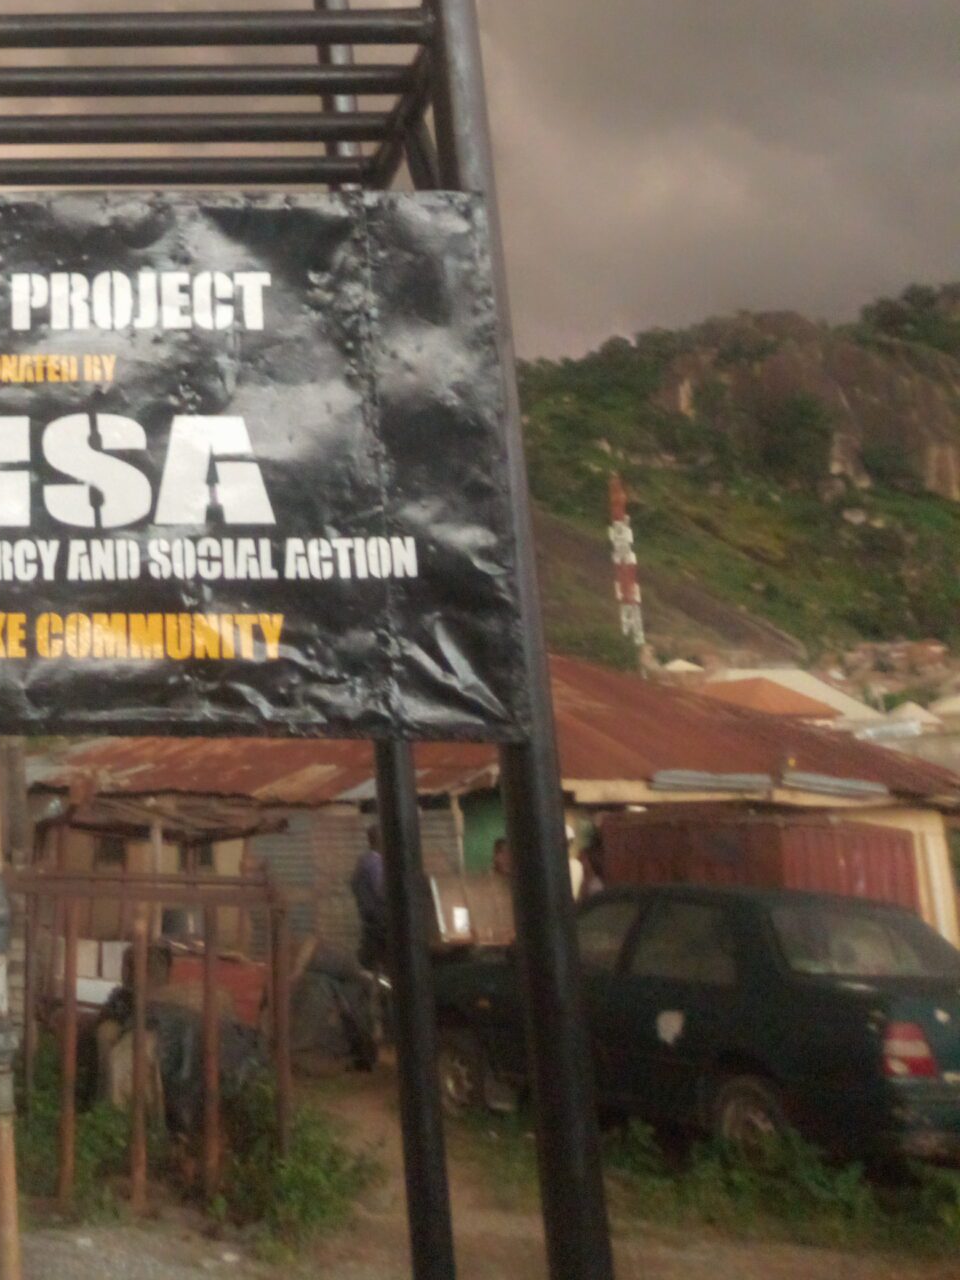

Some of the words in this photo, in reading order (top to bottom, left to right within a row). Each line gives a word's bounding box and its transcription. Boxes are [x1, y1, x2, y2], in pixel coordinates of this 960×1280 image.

[11, 271, 272, 331] PROJECT
[83, 354, 117, 382] BY
[66, 538, 140, 581] AND
[147, 537, 278, 580] SOCIAL
[284, 536, 419, 579] ACTION
[36, 612, 285, 660] COMMUNITY
